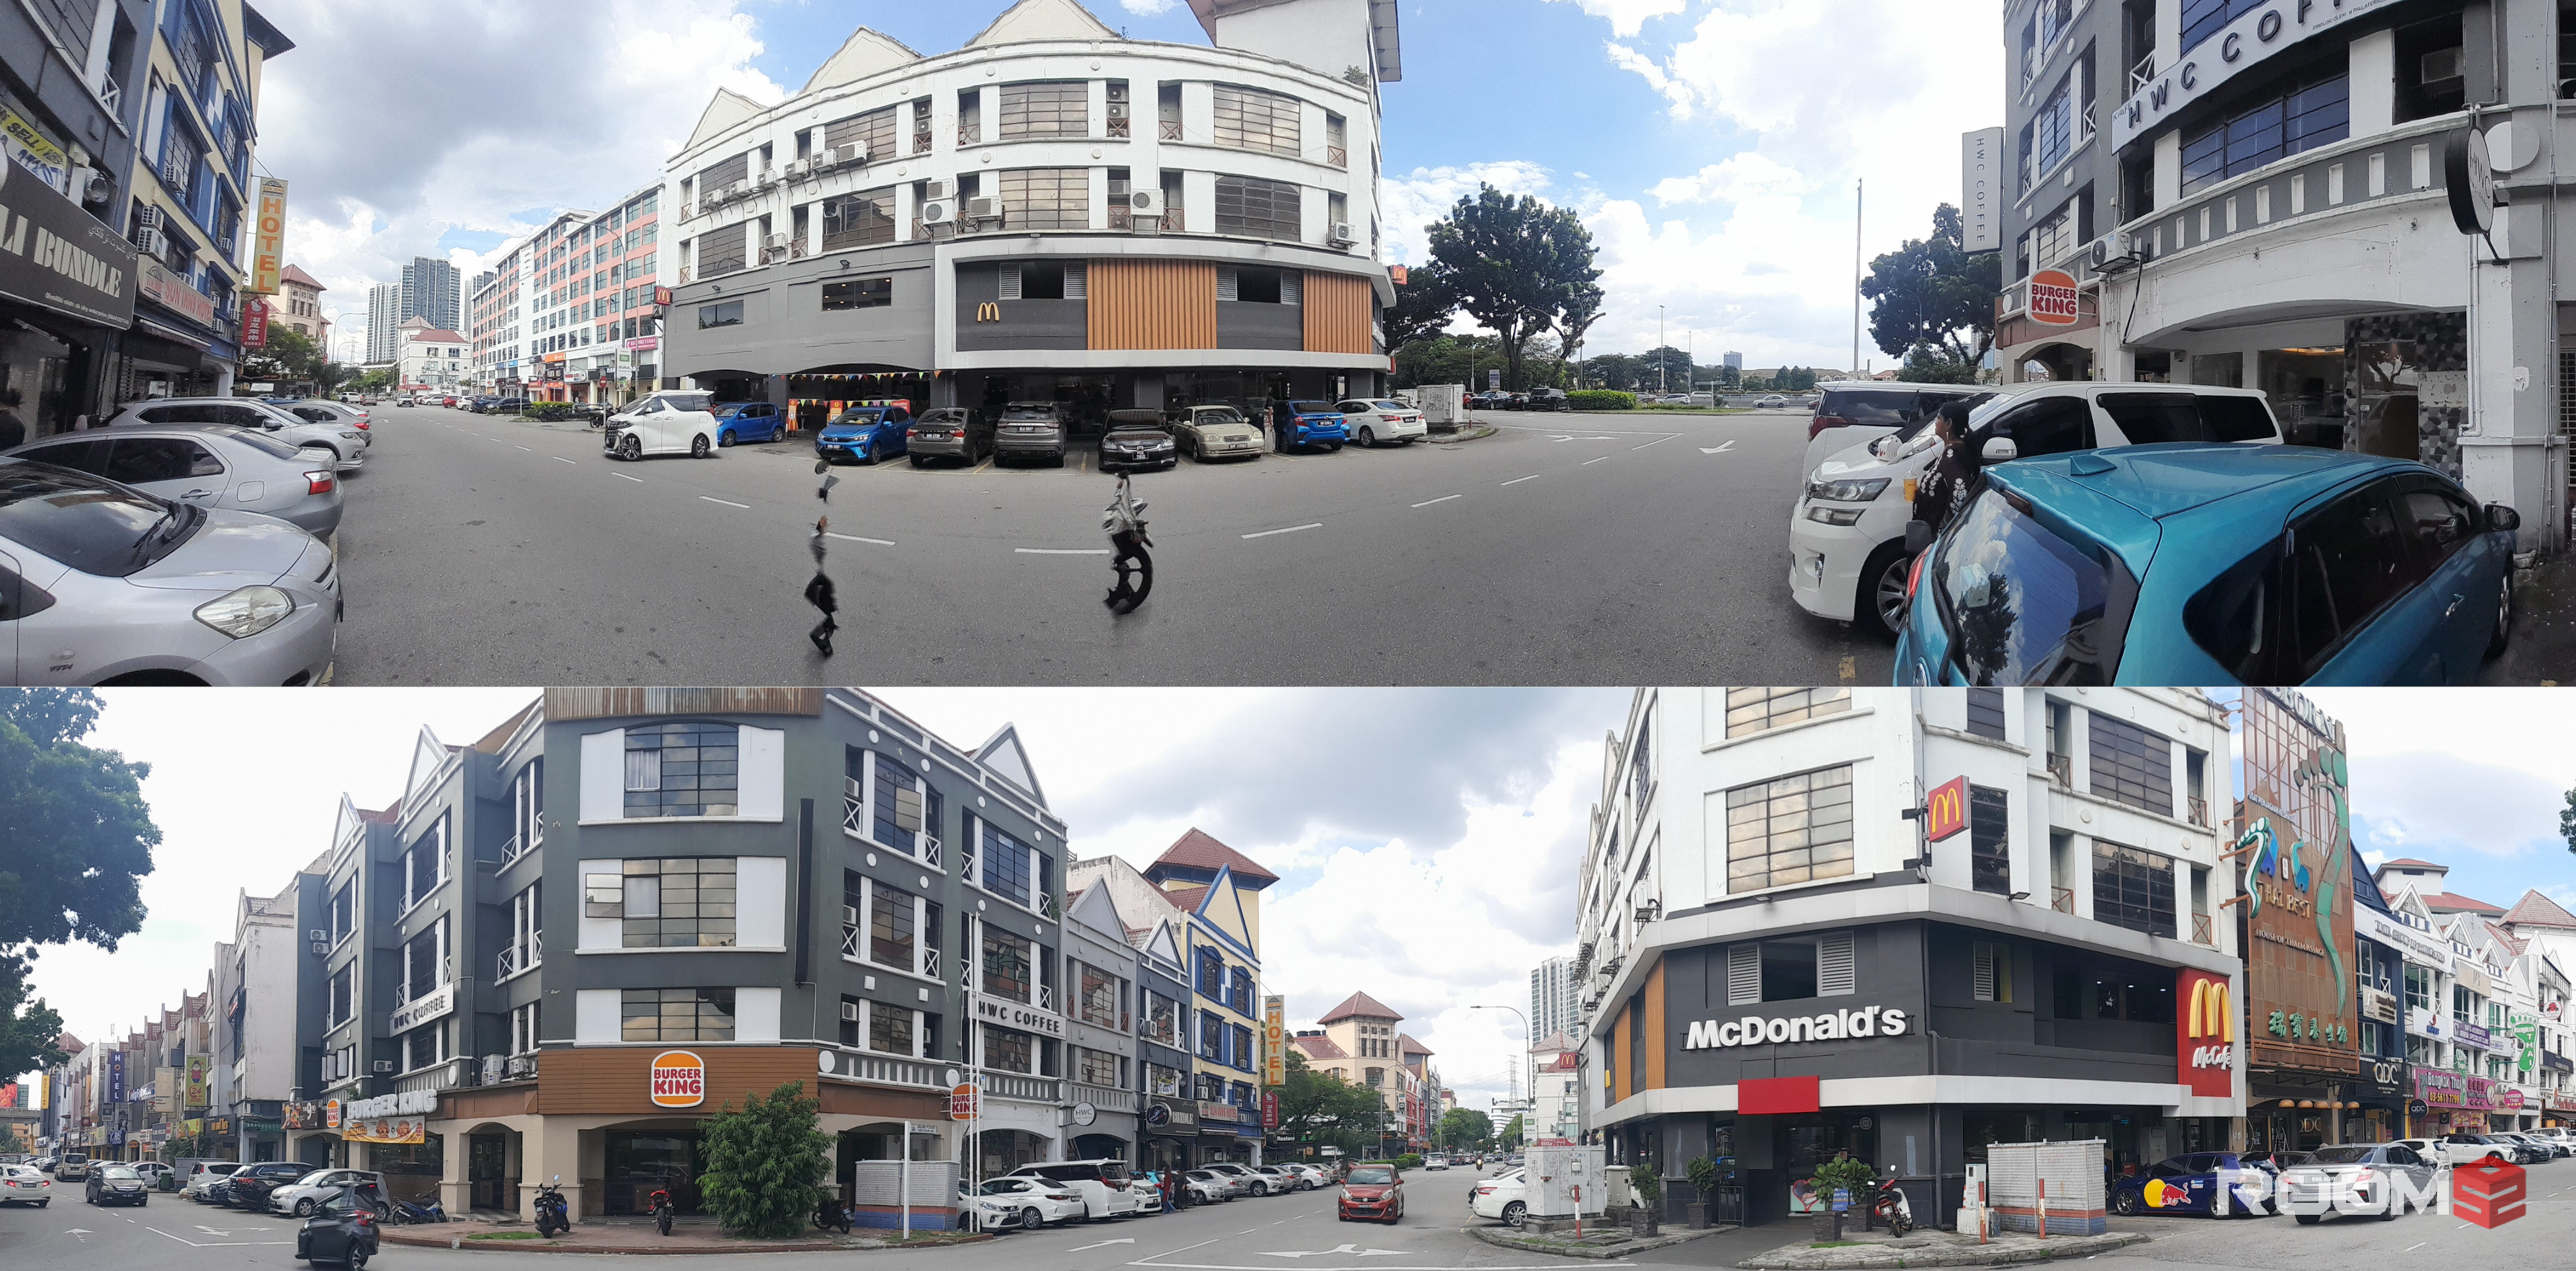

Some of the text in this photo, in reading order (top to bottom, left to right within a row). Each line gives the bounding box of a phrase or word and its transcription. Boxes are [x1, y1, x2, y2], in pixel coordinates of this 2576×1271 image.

[7, 121, 39, 148] SELL
[1977, 180, 1985, 242] COFFEE
[258, 197, 282, 291] HOTEL
[34, 226, 122, 298] BUNDLE
[165, 281, 213, 322] SUN INNS HOTEL
[2032, 284, 2076, 300] BURGER
[2032, 296, 2077, 315] KING
[2286, 894, 2311, 919] BEST
[2257, 929, 2277, 941] HOUSE
[2277, 935, 2285, 944] OF
[978, 1000, 1060, 1033] HWC COFFEE
[1686, 1005, 1907, 1050] McDonald's
[1268, 1011, 1280, 1084] HOTEL
[654, 1069, 701, 1079] BURGER
[2374, 1062, 2399, 1085] QDC
[2427, 1072, 2449, 1090] Bangkok
[2451, 1076, 2461, 1090] Thai
[654, 1079, 701, 1094] KING
[2429, 1092, 2448, 1104] 03-5611
[2449, 1094, 2460, 1104] 7799
[347, 1089, 437, 1120] BURGER KING
[1226, 1108, 1238, 1119] HOTEL
[327, 1114, 339, 1122] KING
[1172, 1111, 1194, 1125] BUNDLE
